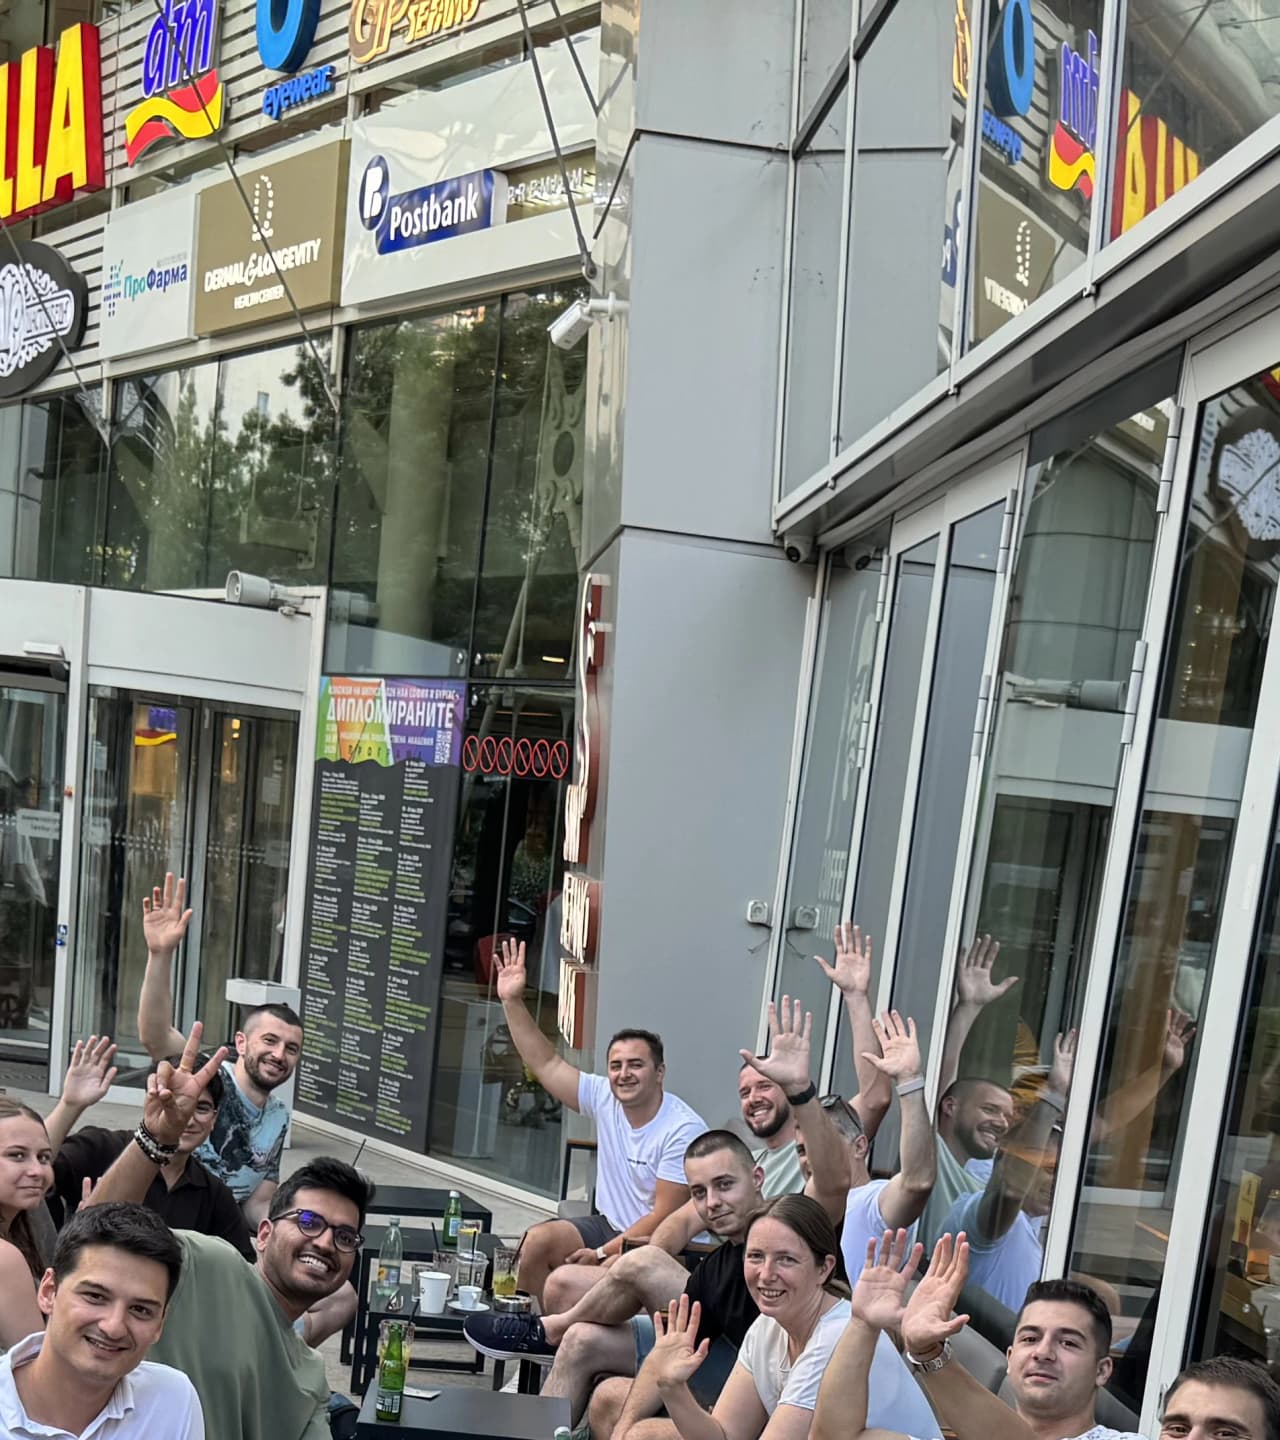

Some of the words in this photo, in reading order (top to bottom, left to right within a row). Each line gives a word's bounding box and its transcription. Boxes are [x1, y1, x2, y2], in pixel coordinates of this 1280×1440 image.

[143, 0, 218, 98] dm
[390, 182, 479, 241] Postbank
[123, 262, 188, 300] ПроФарма
[326, 697, 455, 729] ДИПЛОМИРАНИТЕ
